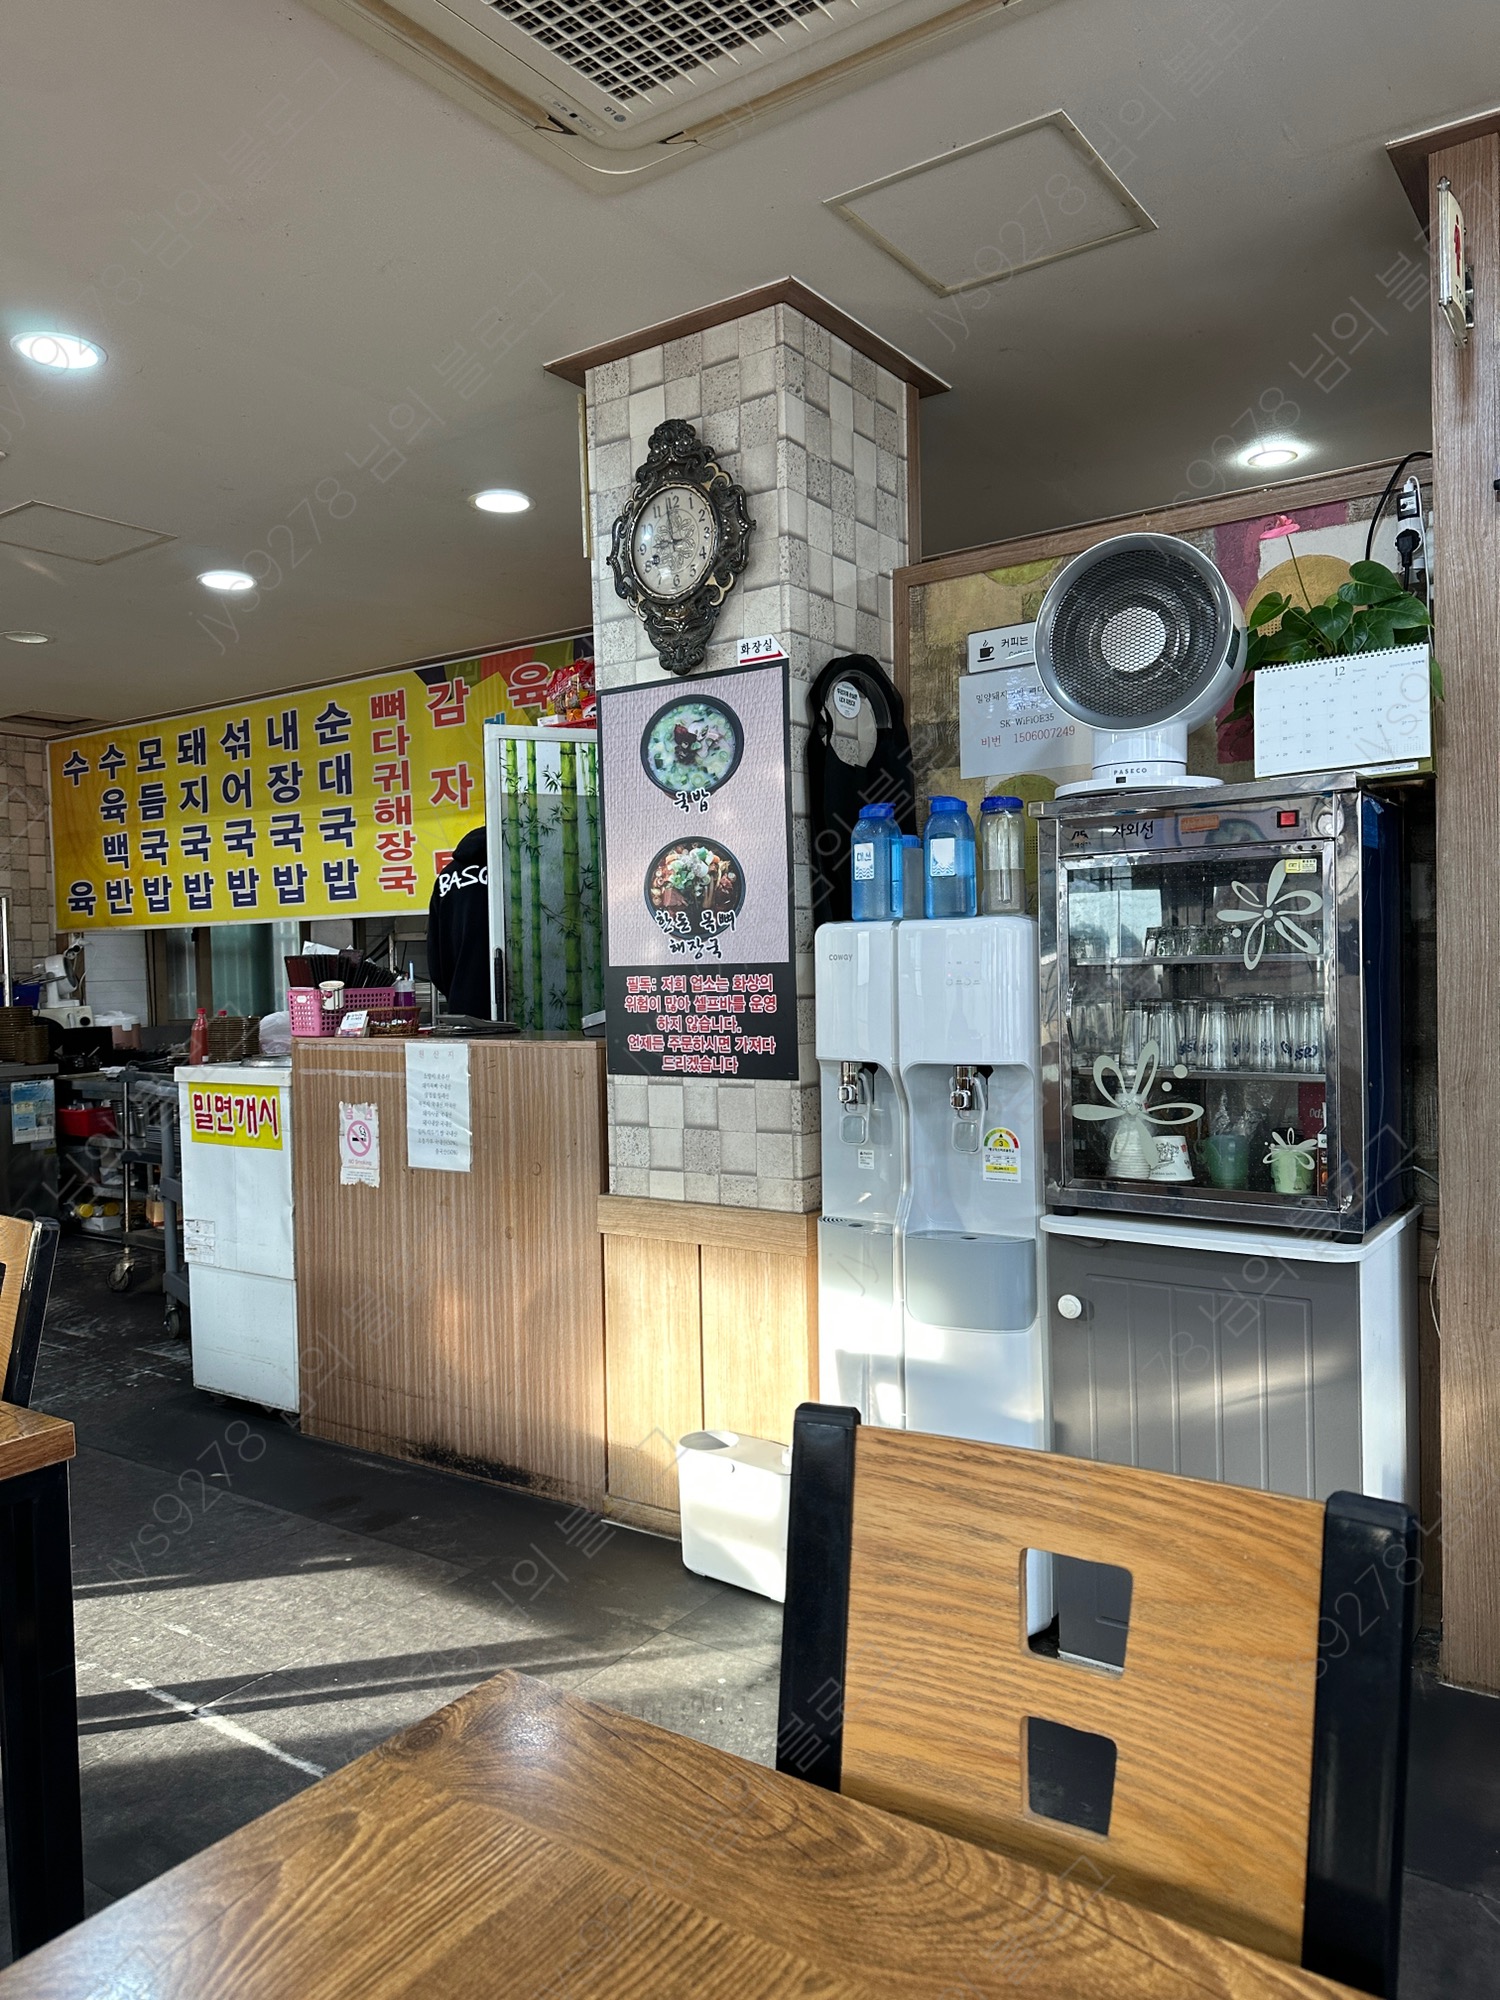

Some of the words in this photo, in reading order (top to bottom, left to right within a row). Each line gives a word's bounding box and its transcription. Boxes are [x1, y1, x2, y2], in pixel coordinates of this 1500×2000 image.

[740, 638, 772, 655] 화장실
[1001, 636, 1029, 648] 커피는
[1334, 666, 1346, 678] 12
[981, 735, 1001, 748] 비번
[1013, 726, 1076, 744] 1506007249
[1114, 767, 1148, 776] PASECO
[674, 789, 710, 813] 국밥
[1112, 820, 1154, 840] 자외선
[669, 938, 723, 961] 해장국
[828, 953, 853, 963] coway
[627, 975, 657, 992] 필독:
[661, 976, 687, 992] 저희
[690, 975, 729, 992] 업소는
[733, 974, 774, 992] 화상의
[624, 996, 661, 1013] 위험이
[664, 996, 690, 1013] 많아
[694, 995, 746, 1013] 셀프바를
[749, 995, 777, 1013] 운영
[656, 1015, 683, 1032] 하지
[686, 1016, 742, 1033] 않습니다.
[627, 1035, 665, 1051] 언제든
[667, 1035, 731, 1052] 주문하시면
[735, 1036, 776, 1054] 가져다
[662, 1055, 738, 1074] 드리겠습니다
[193, 1093, 279, 1139] 밀면개시
